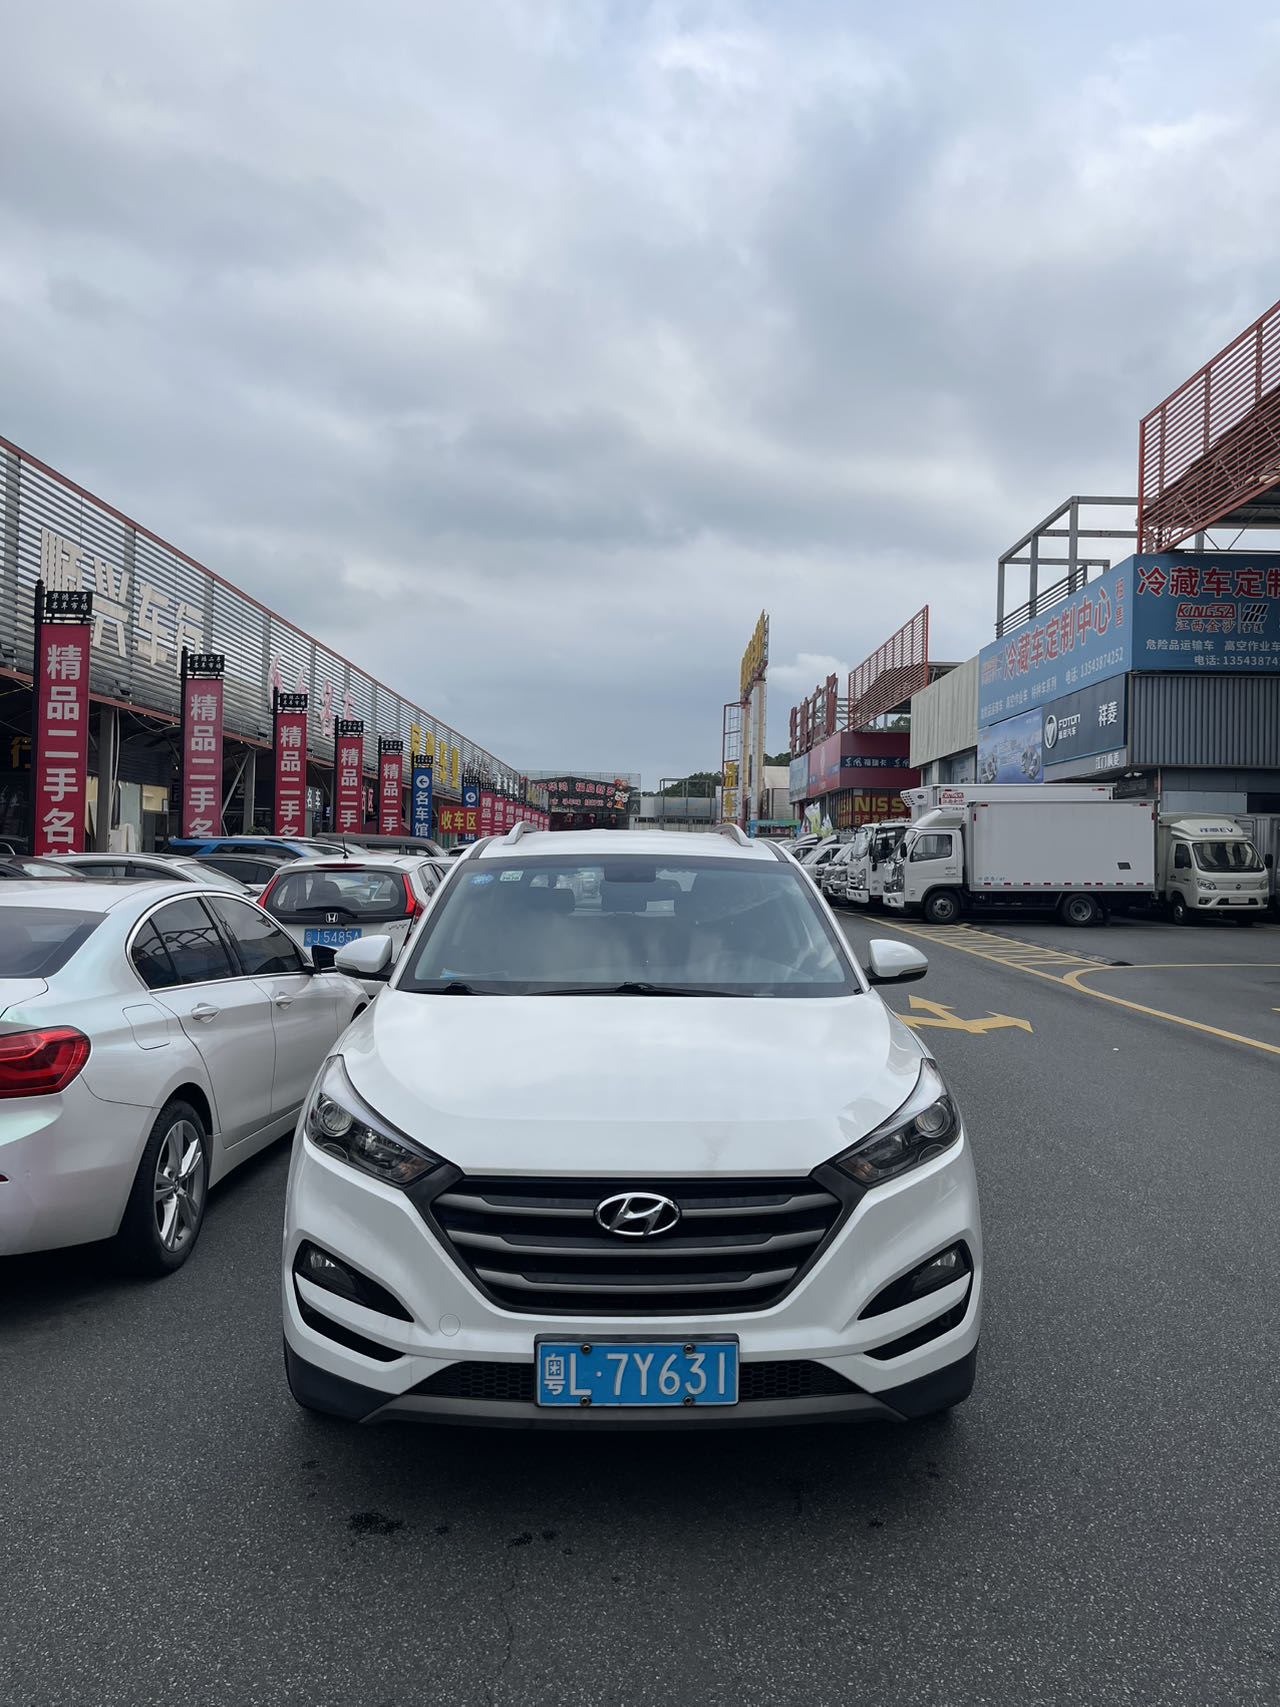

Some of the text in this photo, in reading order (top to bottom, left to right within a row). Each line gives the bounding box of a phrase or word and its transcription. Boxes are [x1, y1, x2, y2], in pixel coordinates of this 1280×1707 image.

[1004, 586, 1112, 681] 冷藏车定制中心
[1145, 639, 1280, 652] 危险品运输车 高空作业车
[1194, 655, 1280, 666] 电话: 13543874
[1058, 714, 1081, 729] FOTON
[1098, 701, 1118, 728] 祥菱
[41, 644, 83, 856] 精品二手名
[340, 747, 359, 834] 精品二手
[414, 790, 429, 837] 名车馆
[441, 810, 477, 831] 收车区
[544, 1353, 725, 1396] 粤L·7Y631
